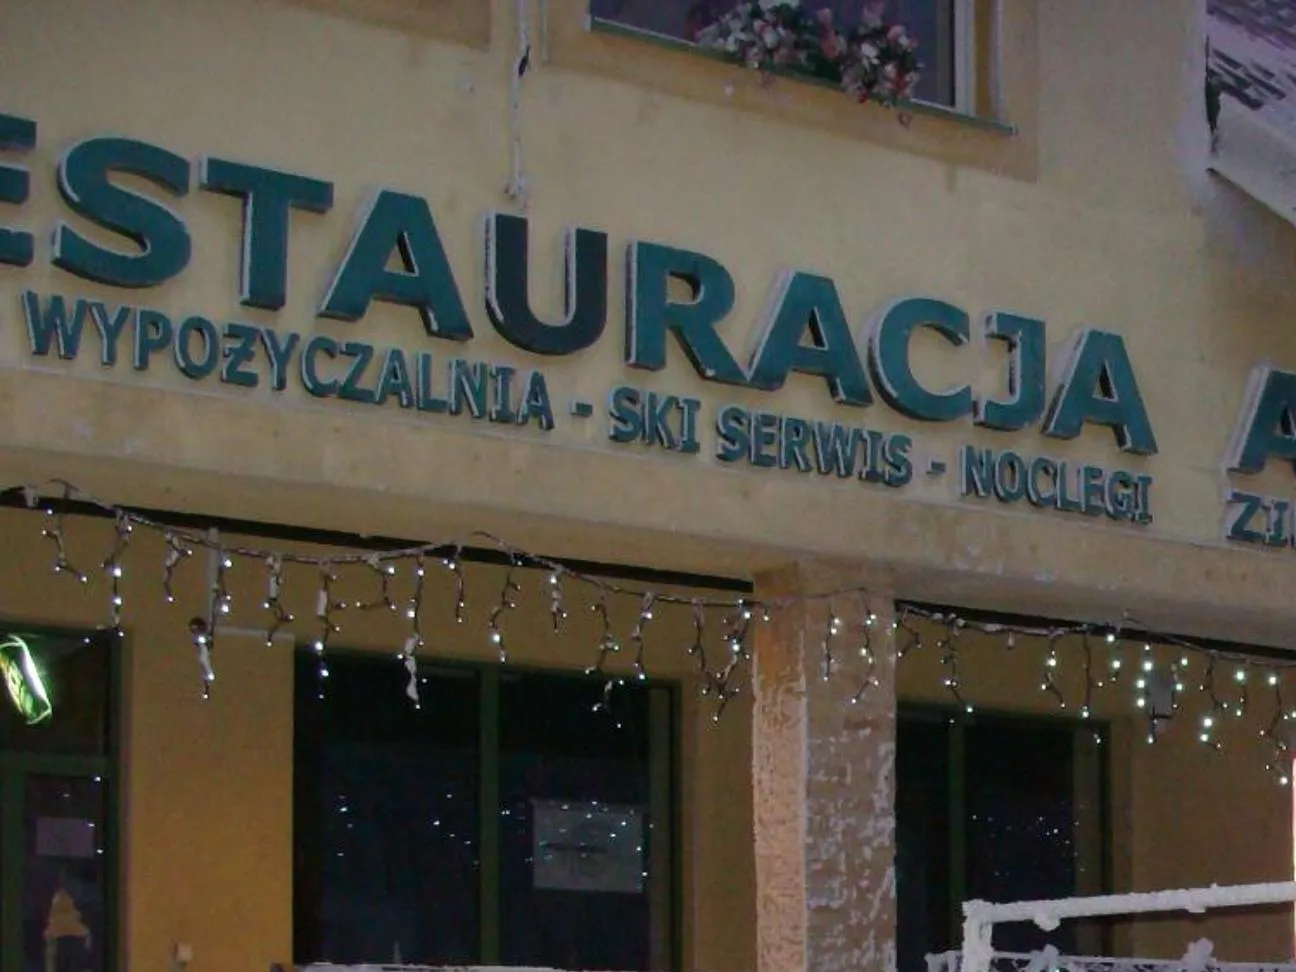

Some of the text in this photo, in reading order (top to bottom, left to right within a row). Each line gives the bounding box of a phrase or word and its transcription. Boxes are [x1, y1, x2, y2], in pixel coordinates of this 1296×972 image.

[608, 385, 701, 454] SKI
[715, 405, 912, 488] SERWIS
[957, 443, 1155, 525] NOCLEGI
